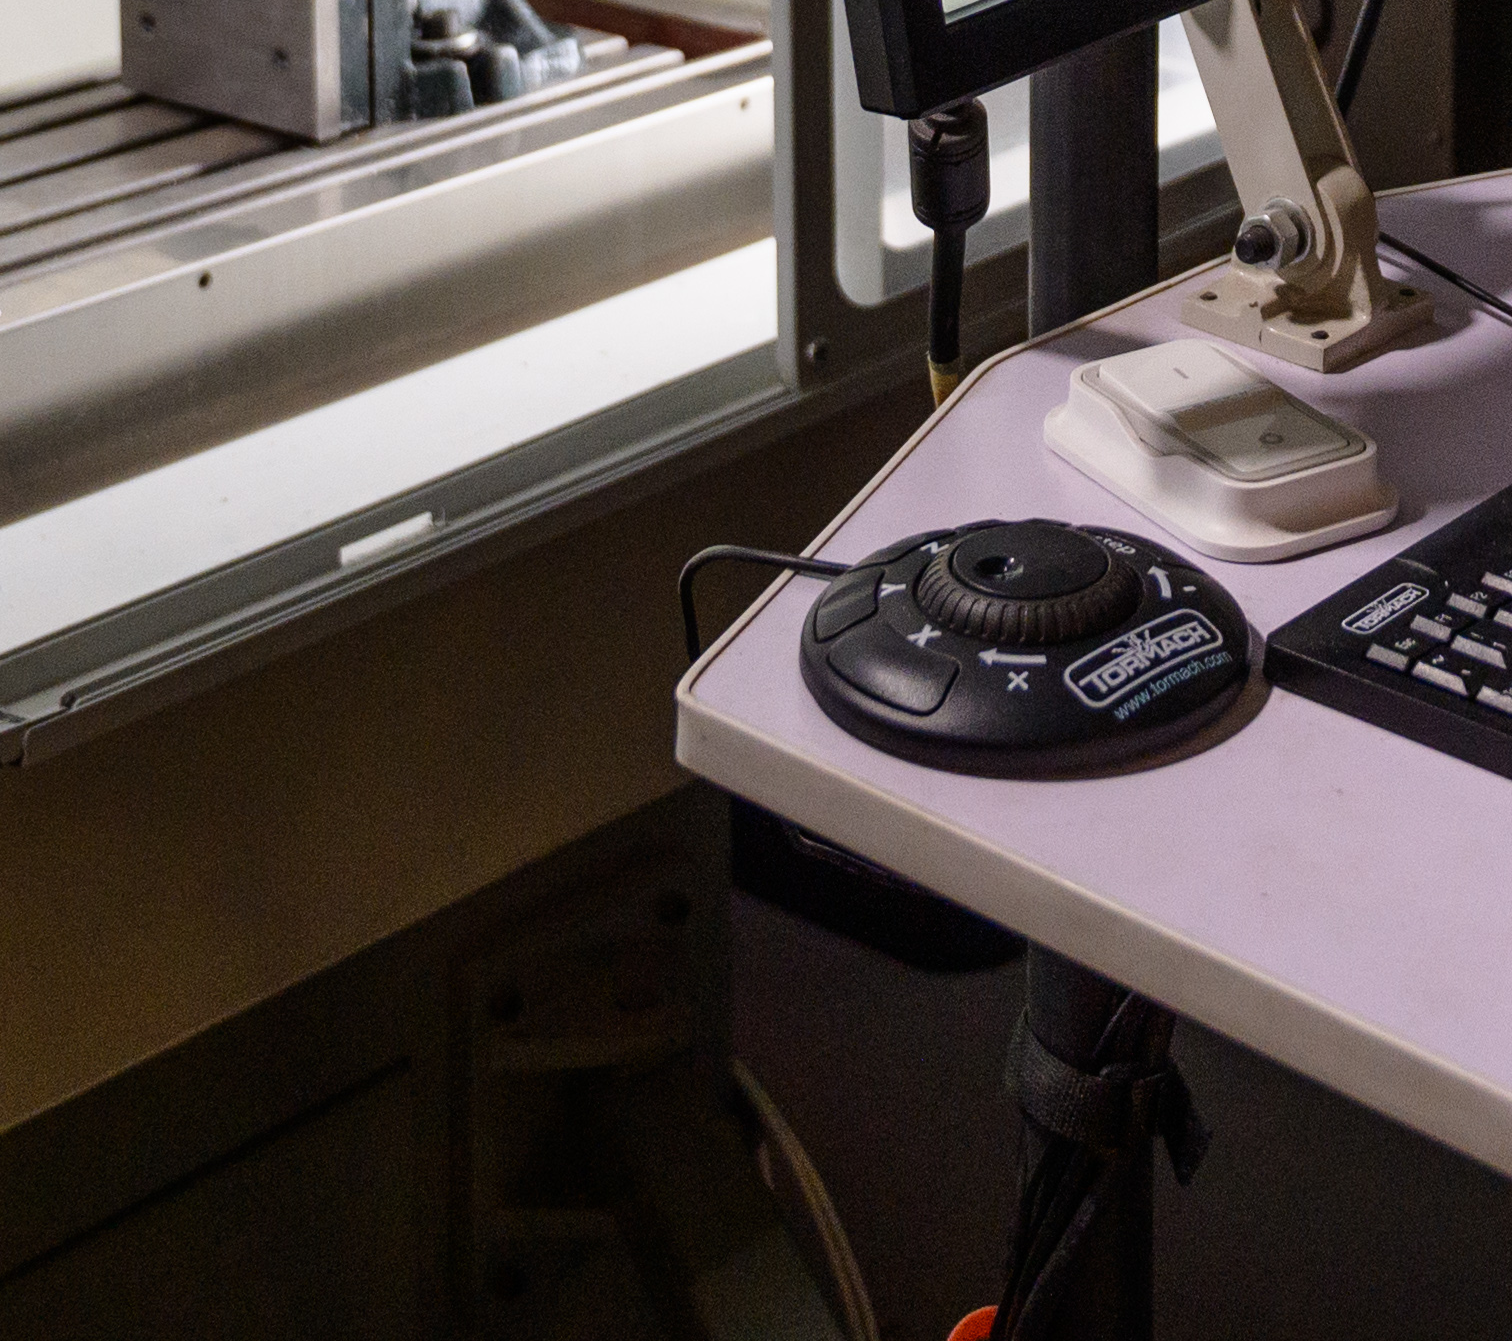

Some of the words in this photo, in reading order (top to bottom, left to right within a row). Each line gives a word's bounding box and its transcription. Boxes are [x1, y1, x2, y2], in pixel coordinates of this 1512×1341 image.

[879, 582, 907, 598] Y
[1351, 586, 1423, 631] TORMACH
[906, 623, 943, 648] X
[1080, 621, 1211, 695] TORMACH
[1113, 649, 1233, 722] www.tormach.com
